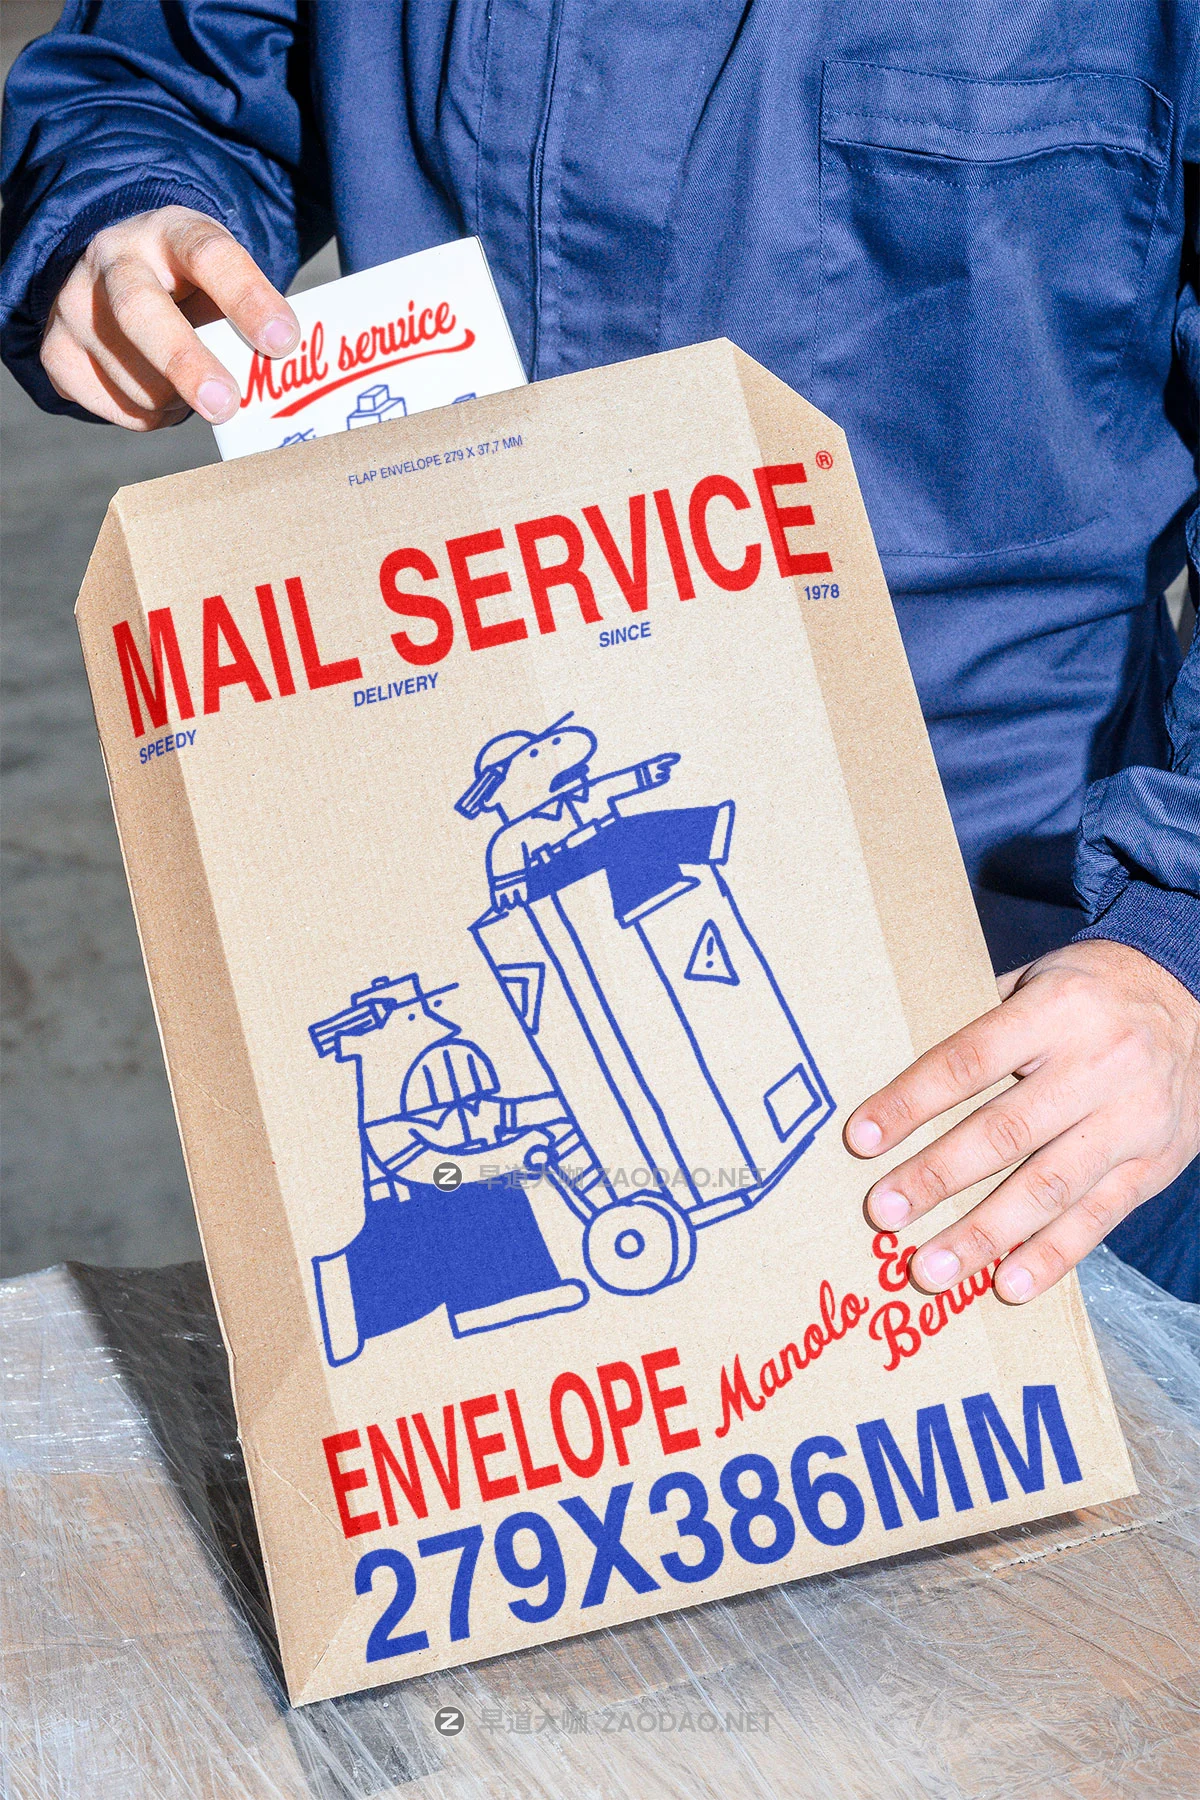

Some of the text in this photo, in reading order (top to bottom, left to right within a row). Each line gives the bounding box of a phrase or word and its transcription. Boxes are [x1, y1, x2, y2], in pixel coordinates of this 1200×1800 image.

[240, 300, 456, 408] Mail service
[349, 435, 523, 486] FLAP ENVELOPE 279 X 37,7 MM
[112, 576, 363, 738] MAIL
[139, 583, 840, 765] SPEEDY DELIVERY SINCE 1978
[715, 1230, 918, 1439] Manolo &
[321, 1347, 701, 1539] ENVELOPE
[353, 1383, 1084, 1664] 279X386MM
